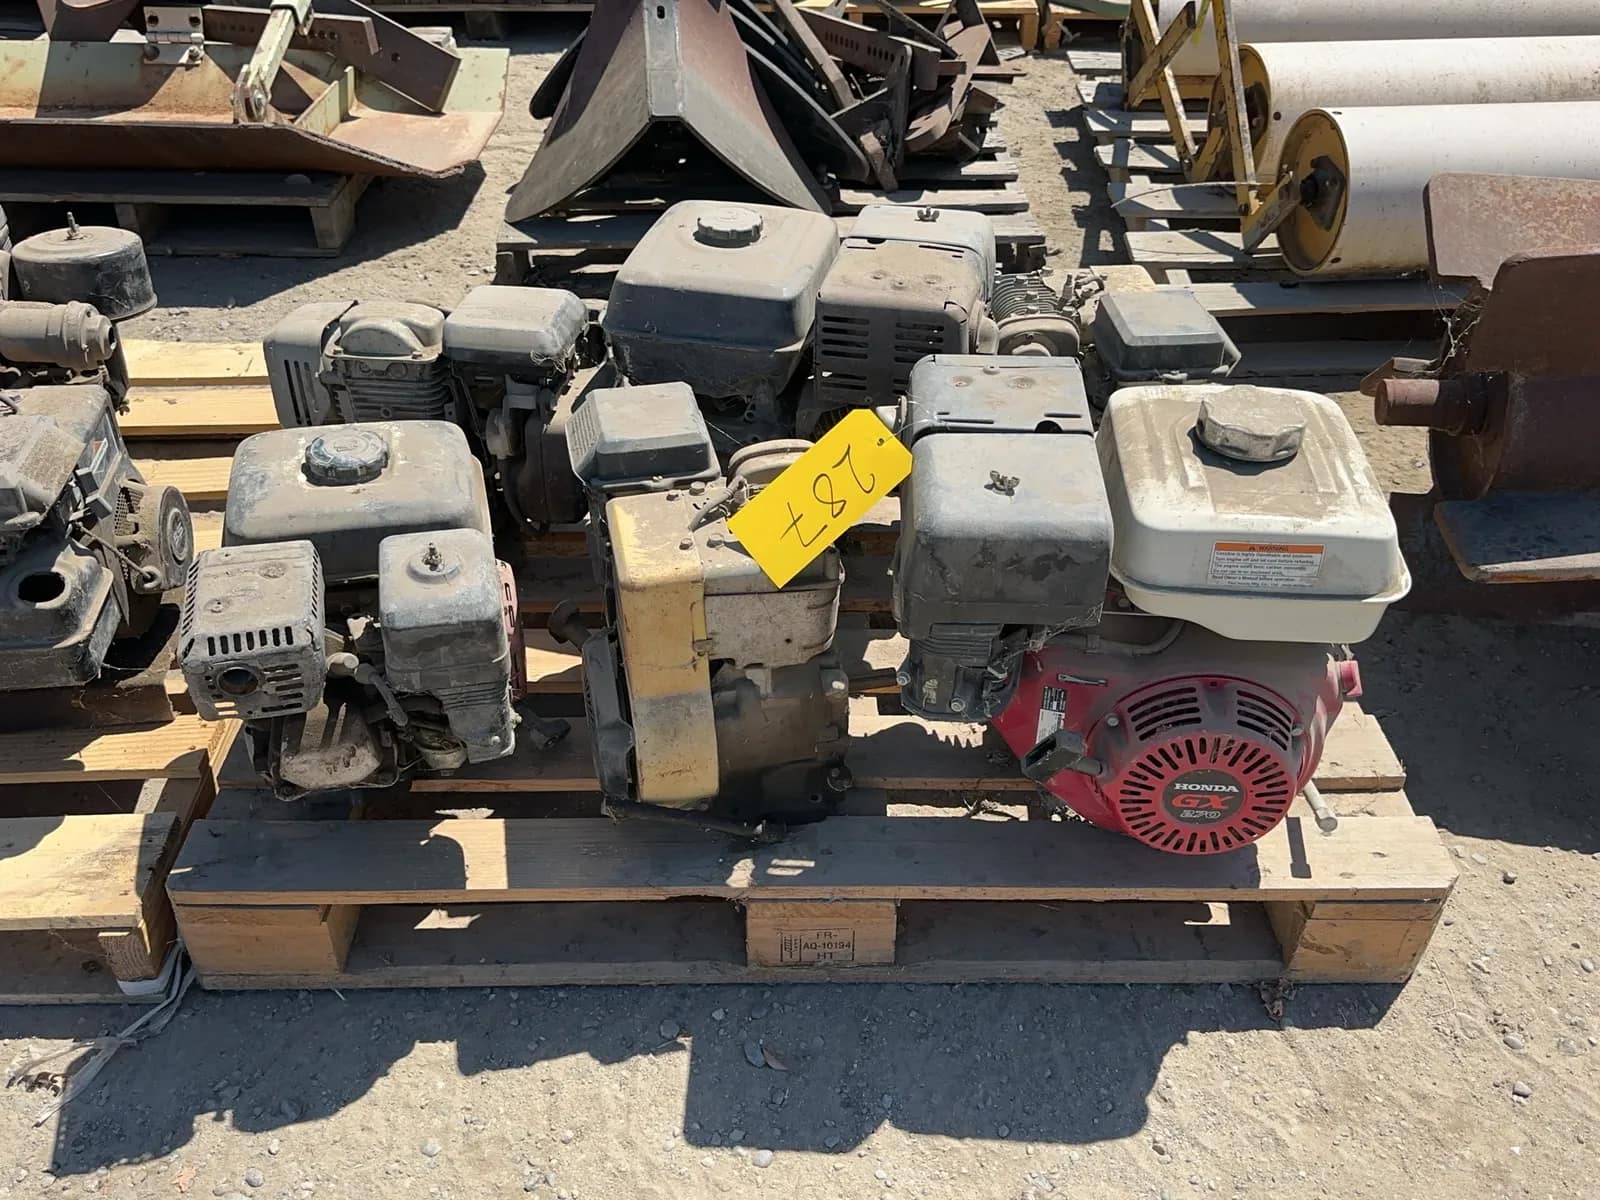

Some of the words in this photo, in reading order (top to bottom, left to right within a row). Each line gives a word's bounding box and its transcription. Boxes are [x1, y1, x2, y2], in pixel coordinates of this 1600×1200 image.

[779, 443, 876, 548] 287
[1174, 783, 1239, 793] HONDA
[1172, 794, 1235, 810] GX
[1180, 810, 1222, 819] 270
